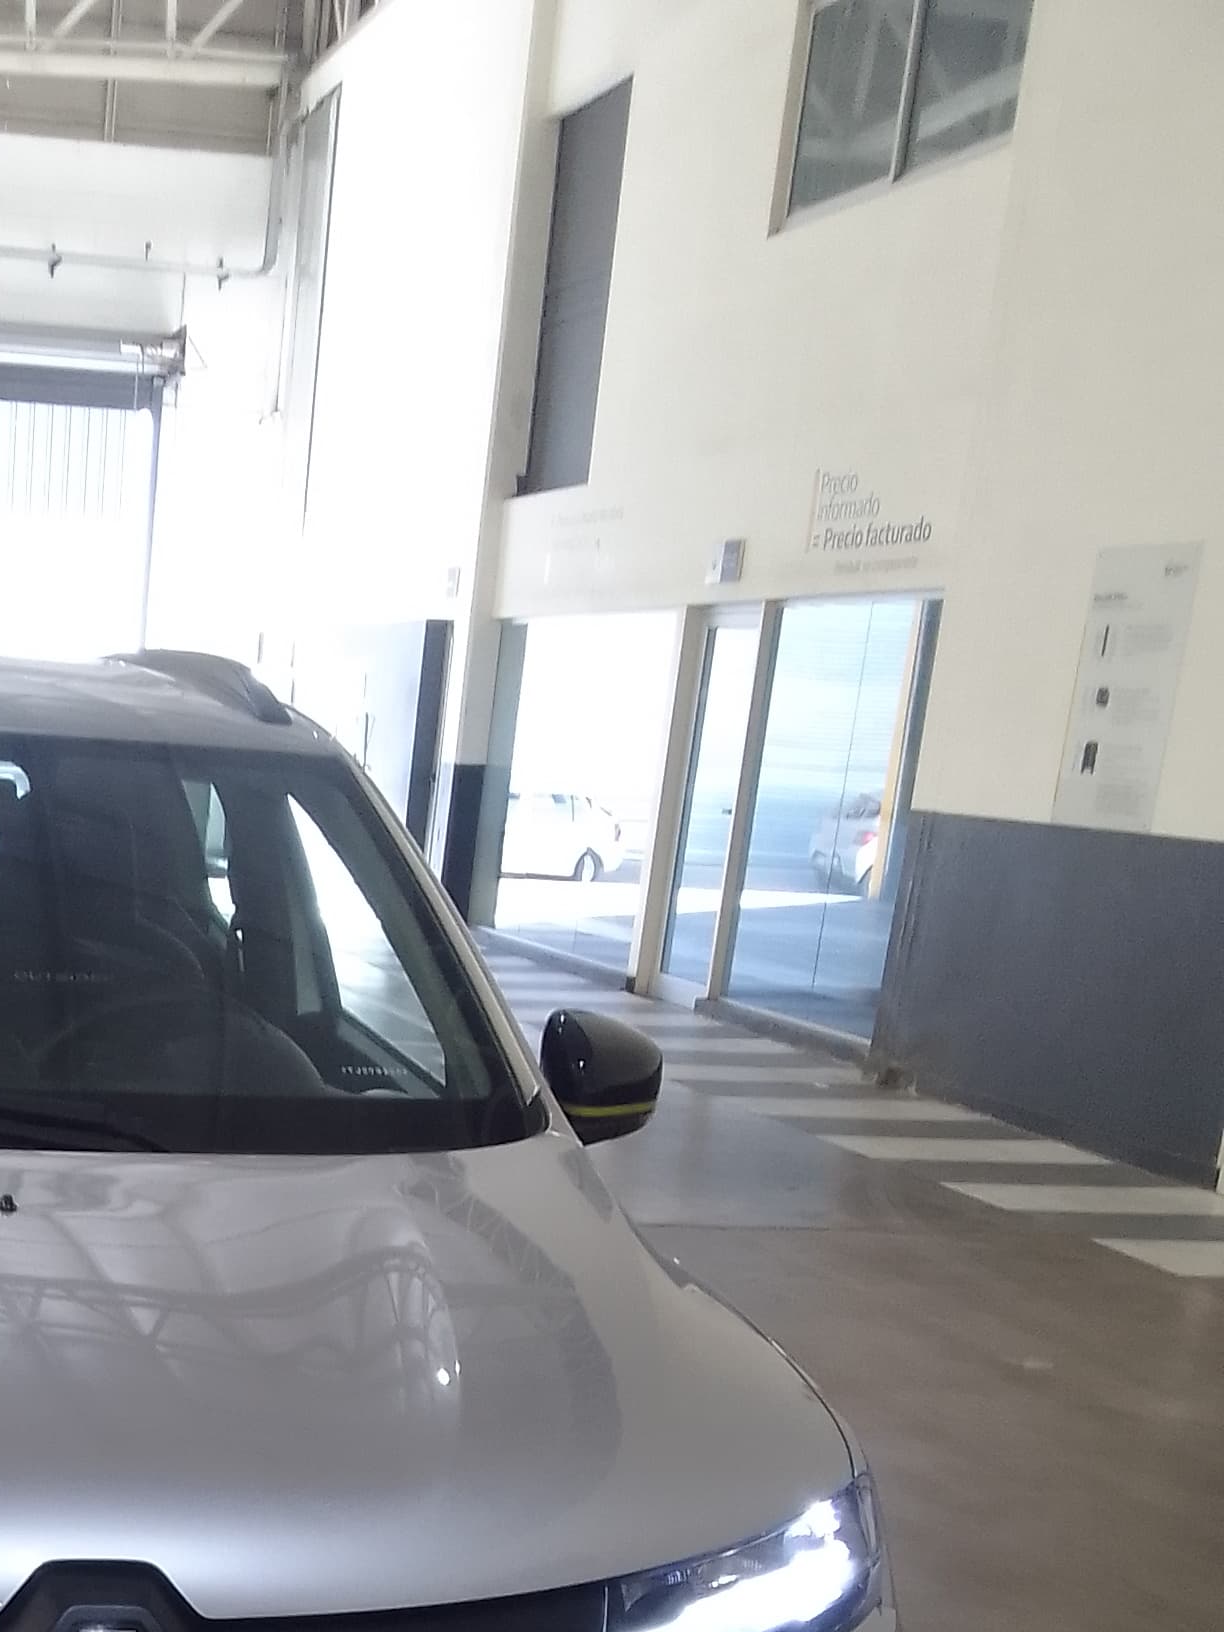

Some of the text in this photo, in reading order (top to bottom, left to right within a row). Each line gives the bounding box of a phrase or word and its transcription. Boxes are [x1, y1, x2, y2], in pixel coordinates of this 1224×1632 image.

[821, 470, 858, 494] Precio
[823, 524, 864, 551] Precio
[865, 515, 933, 547] facturado
